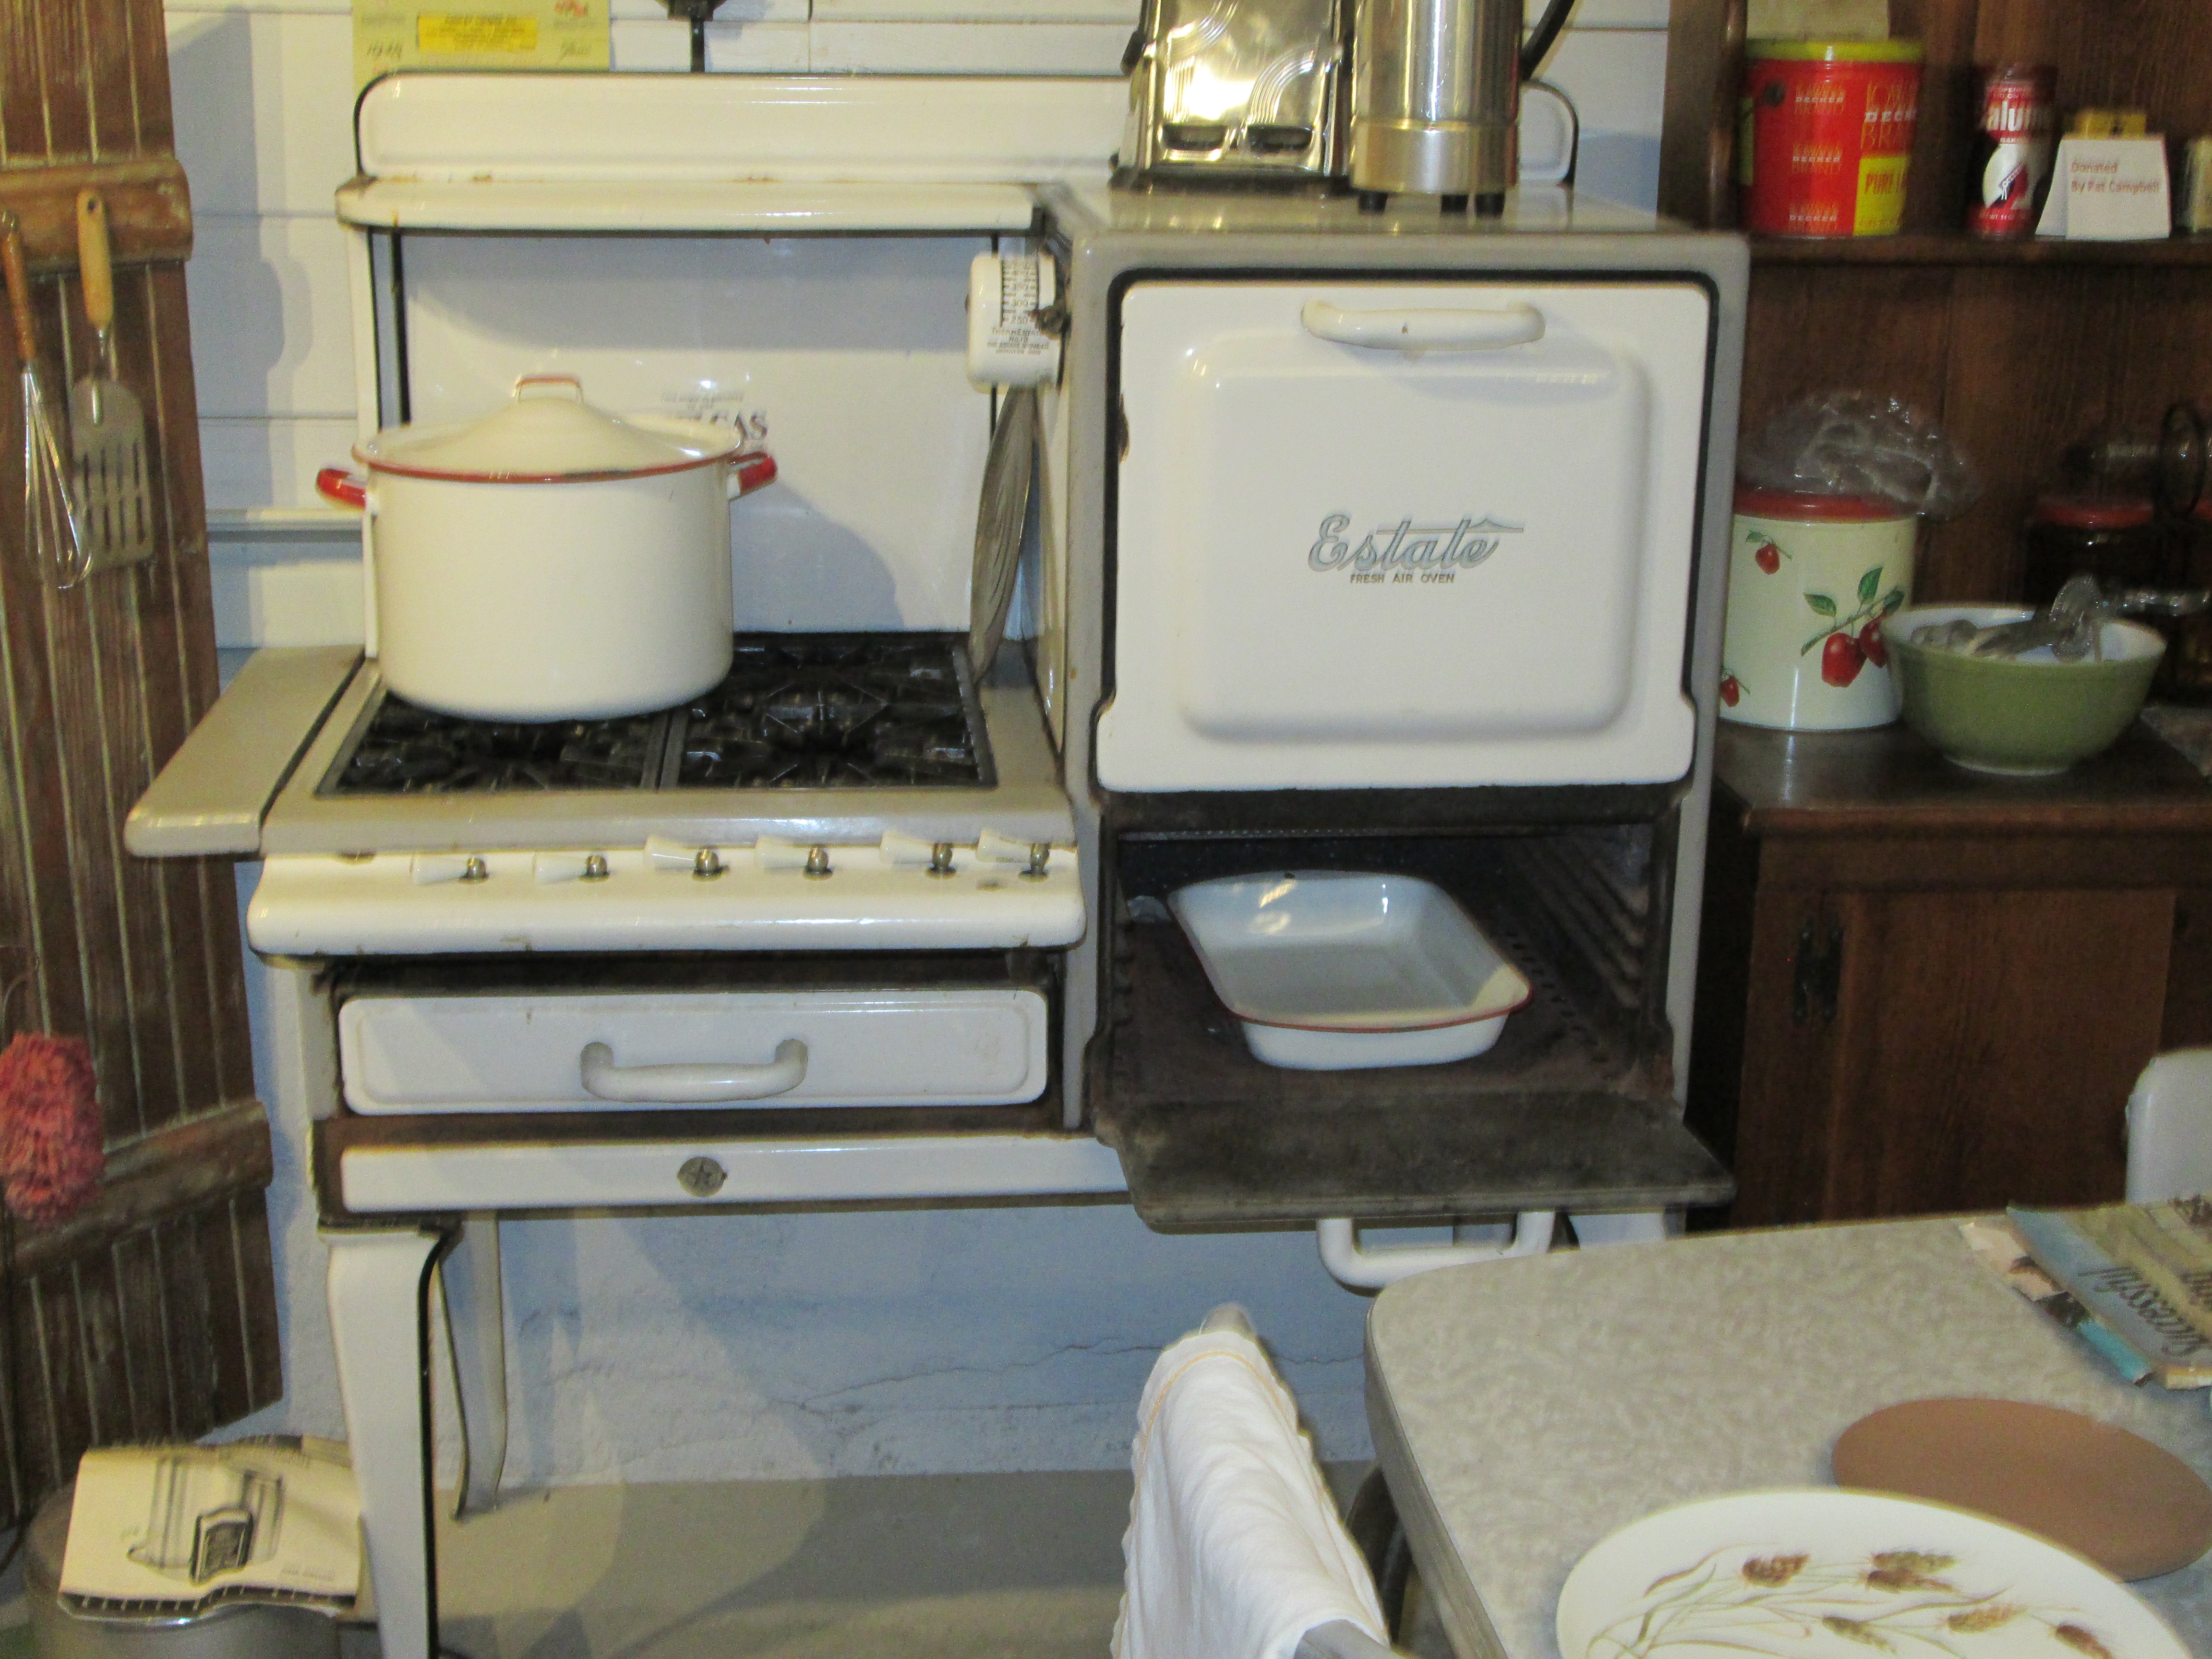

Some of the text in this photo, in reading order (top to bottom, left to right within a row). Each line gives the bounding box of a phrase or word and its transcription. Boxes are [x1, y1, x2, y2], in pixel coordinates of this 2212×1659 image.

[1864, 110, 1917, 122] DECK
[2071, 161, 2118, 173] Donated
[2071, 180, 2085, 194] By
[1011, 298, 1028, 307] 300
[1010, 316, 1028, 325] 250
[1308, 514, 1524, 572] Estate
[1350, 574, 1455, 584] FRESH AIR OVEN
